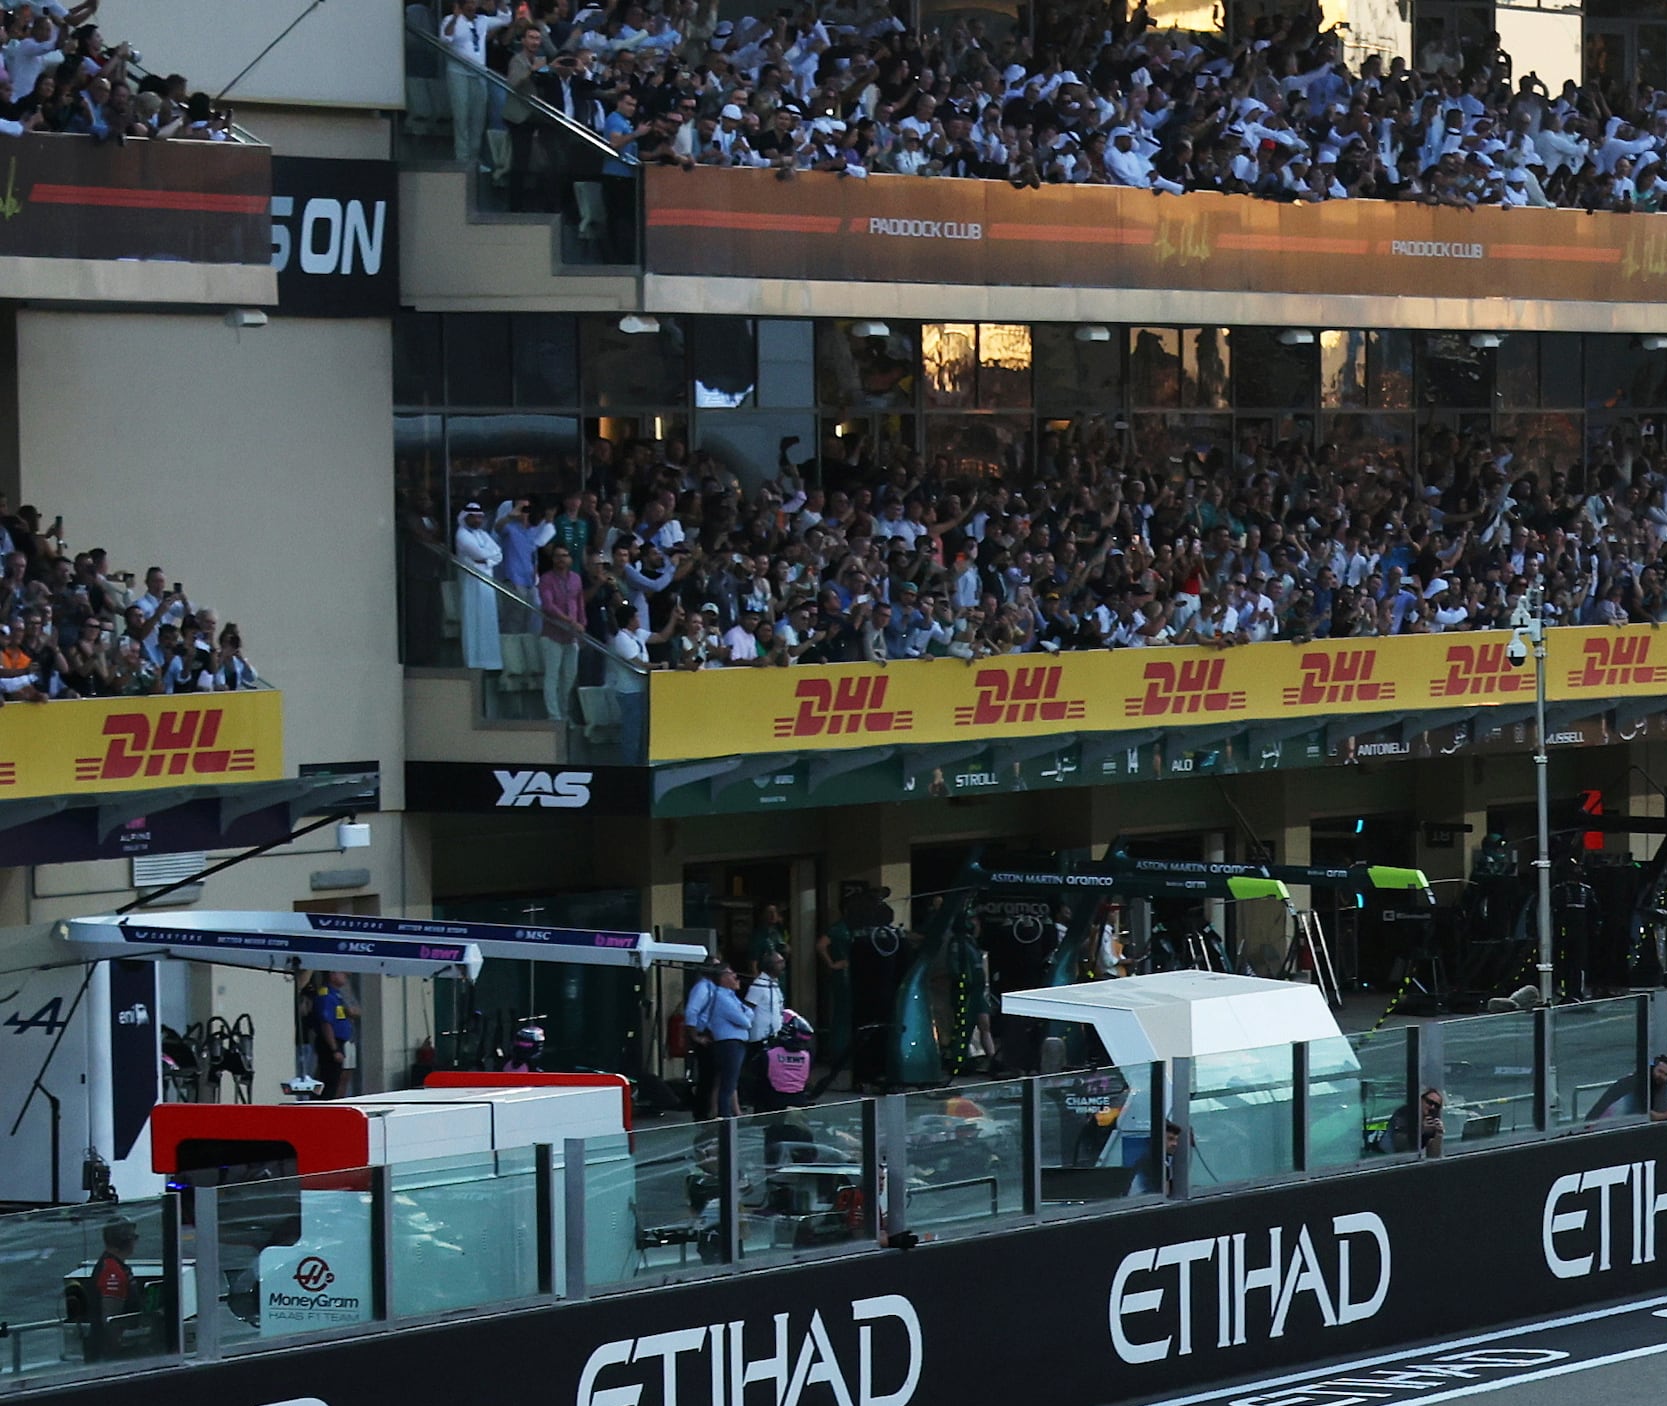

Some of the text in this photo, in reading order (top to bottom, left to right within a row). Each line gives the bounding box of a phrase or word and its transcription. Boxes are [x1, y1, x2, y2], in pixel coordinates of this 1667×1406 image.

[869, 217, 982, 240] PADDOCK CLUB
[1391, 240, 1484, 259] PADDOCK CLUB
[1444, 644, 1522, 696] DHL
[1582, 636, 1655, 686] DHL
[1141, 659, 1230, 716] DHL
[1298, 651, 1382, 704] DHL
[793, 675, 894, 737] DHL
[973, 666, 1067, 725] DHL
[100, 709, 232, 780] DHL
[493, 770, 593, 808] YAS
[955, 773, 999, 788] STROLL
[991, 873, 1113, 888] ASTON MARTIN aramco
[1184, 879, 1207, 890] arm
[1209, 864, 1252, 876] aram
[348, 942, 376, 955] MSC
[525, 930, 552, 942] MSC
[269, 1292, 360, 1312] MoneyGram
[1109, 1212, 1391, 1364] ETIHAD
